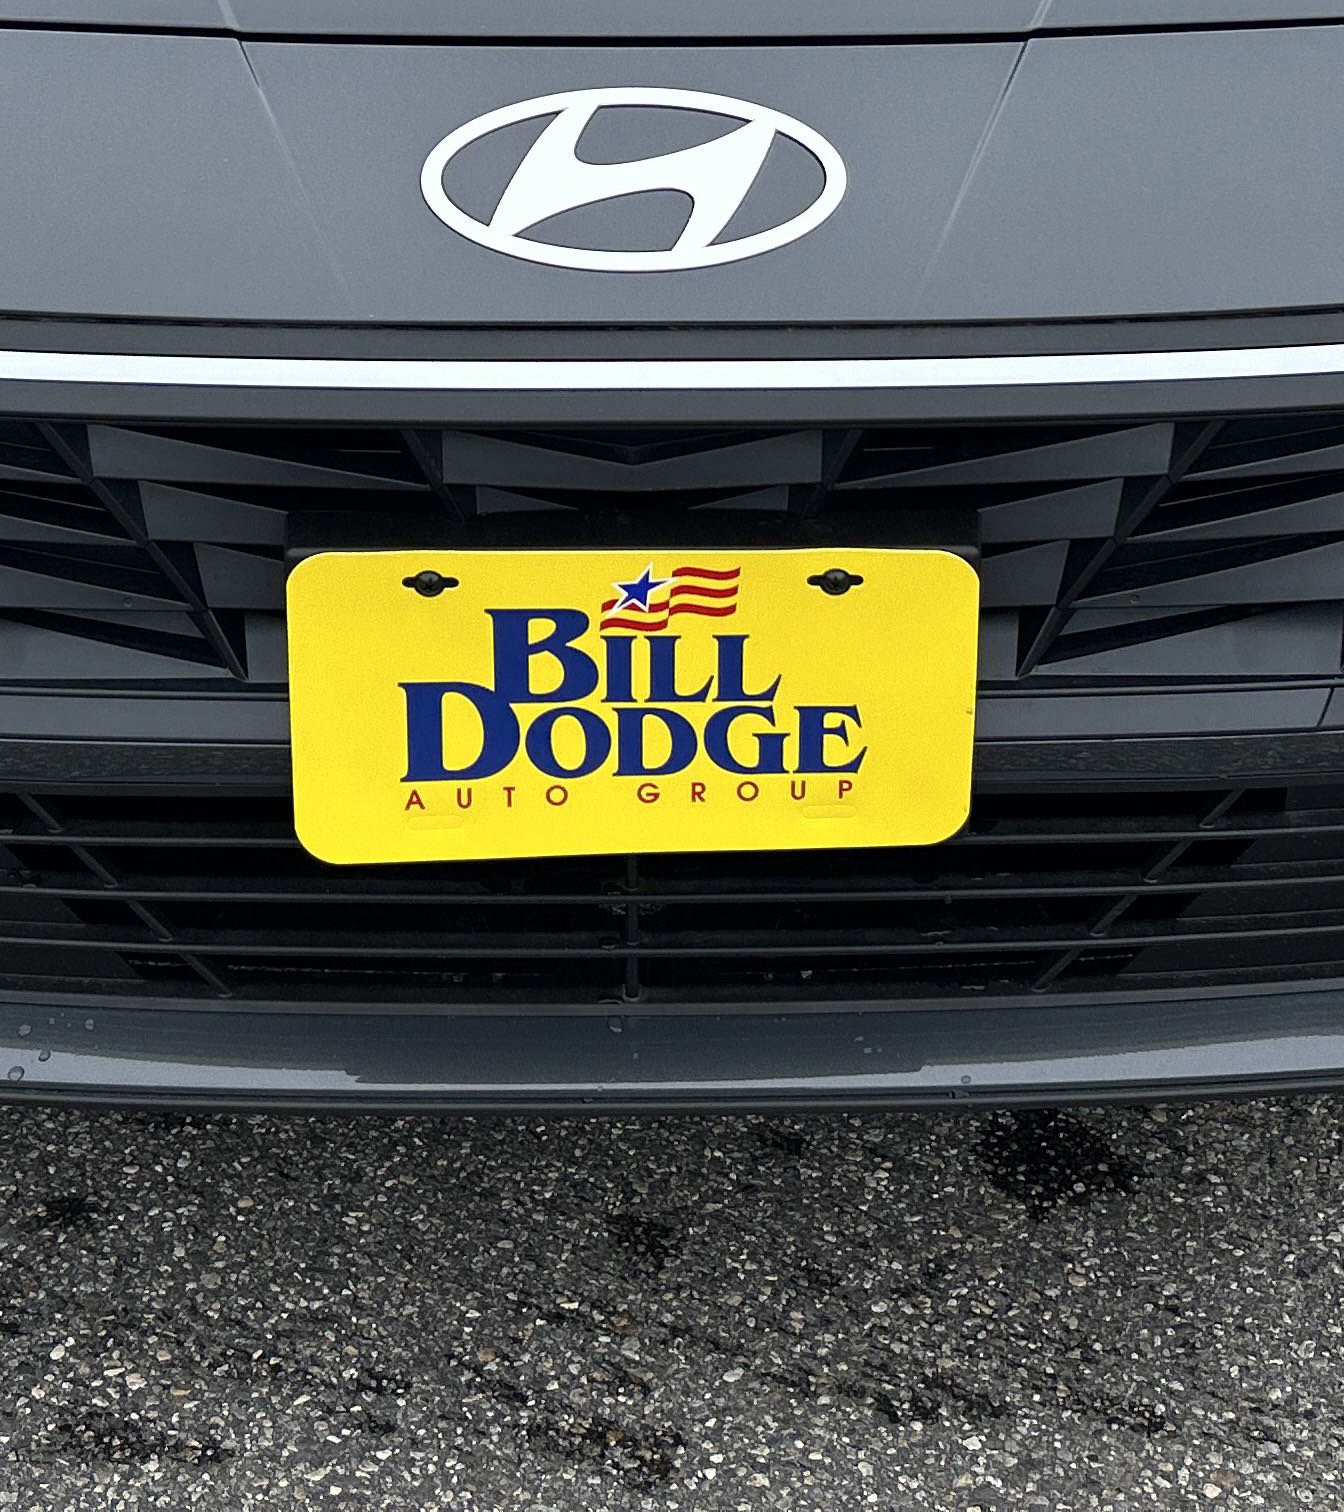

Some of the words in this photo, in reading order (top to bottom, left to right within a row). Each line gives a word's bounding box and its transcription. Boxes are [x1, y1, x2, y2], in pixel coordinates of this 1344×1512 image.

[485, 608, 782, 704] BILL
[398, 681, 868, 783] DODGE
[404, 785, 570, 811] AUTO
[636, 779, 854, 804] GROUP
